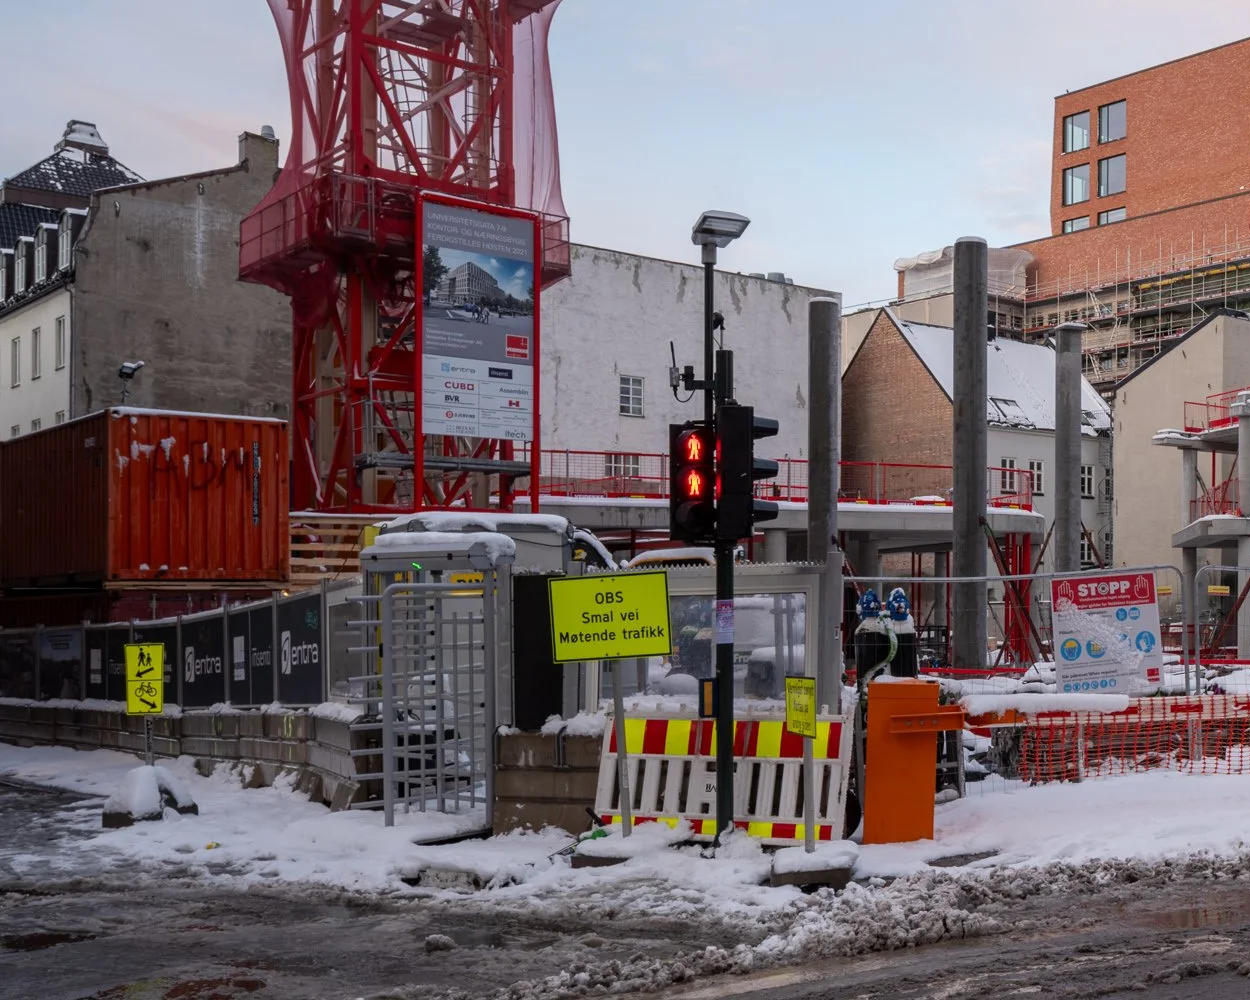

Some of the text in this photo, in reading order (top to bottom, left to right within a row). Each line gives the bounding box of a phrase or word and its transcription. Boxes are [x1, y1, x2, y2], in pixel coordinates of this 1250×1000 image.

[427, 211, 496, 232] UNIVERSITETSGATA
[427, 232, 528, 256] FERDIGSTILLES HØSTEN 2021
[461, 228, 473, 237] OG
[473, 230, 527, 246] NÆRINGSBYGG
[451, 366, 476, 374] entra
[444, 394, 460, 402] BVR
[499, 387, 529, 396] Assemblin
[595, 591, 624, 604] OBS
[1078, 581, 1130, 597] STOPP
[582, 608, 639, 624] Smal vei
[559, 625, 665, 644] Møtende trafikk
[291, 641, 319, 665] entra
[194, 655, 222, 675] entra
